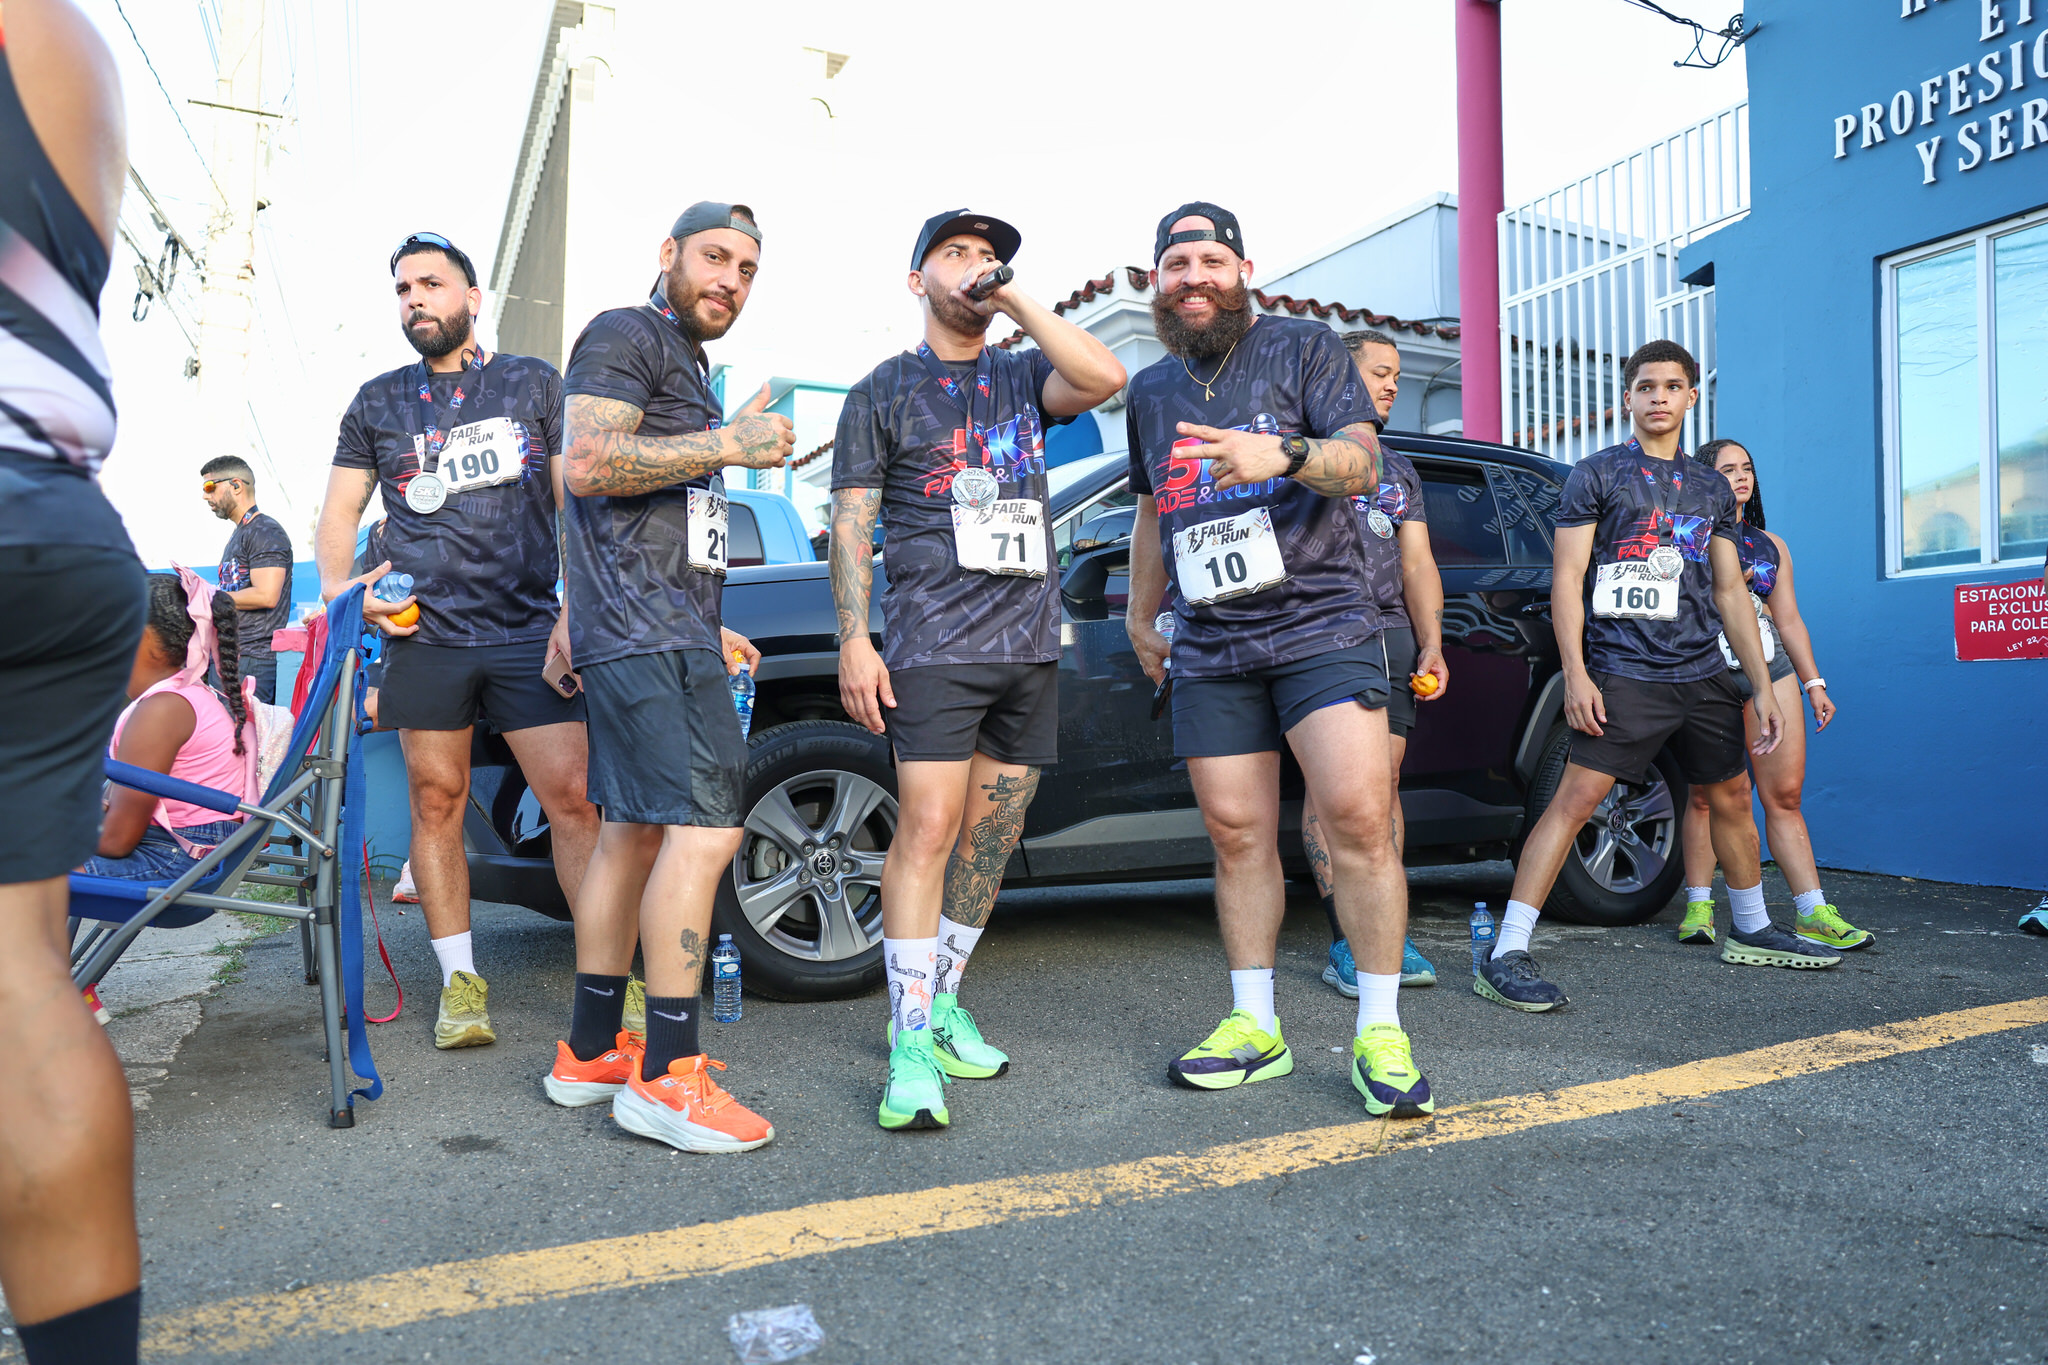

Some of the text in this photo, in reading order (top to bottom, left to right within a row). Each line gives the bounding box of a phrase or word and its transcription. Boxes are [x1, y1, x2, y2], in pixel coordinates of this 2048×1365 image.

[1916, 98, 2048, 184] Y SER
[450, 424, 481, 441] FADE
[468, 432, 494, 446] RUN
[443, 449, 499, 482] 190
[992, 503, 1027, 514] FADE
[1157, 488, 1197, 517] ADE
[1197, 486, 1215, 504] &
[1012, 514, 1037, 525] RUN
[1201, 519, 1236, 538] FADE
[707, 528, 727, 563] 21
[1221, 527, 1250, 545] RUN
[991, 533, 1026, 562] 71
[1205, 552, 1247, 588] 10
[1611, 586, 1660, 609] 160
[1971, 617, 2048, 633] PARA COLE
[2007, 641, 2023, 652] LEY
